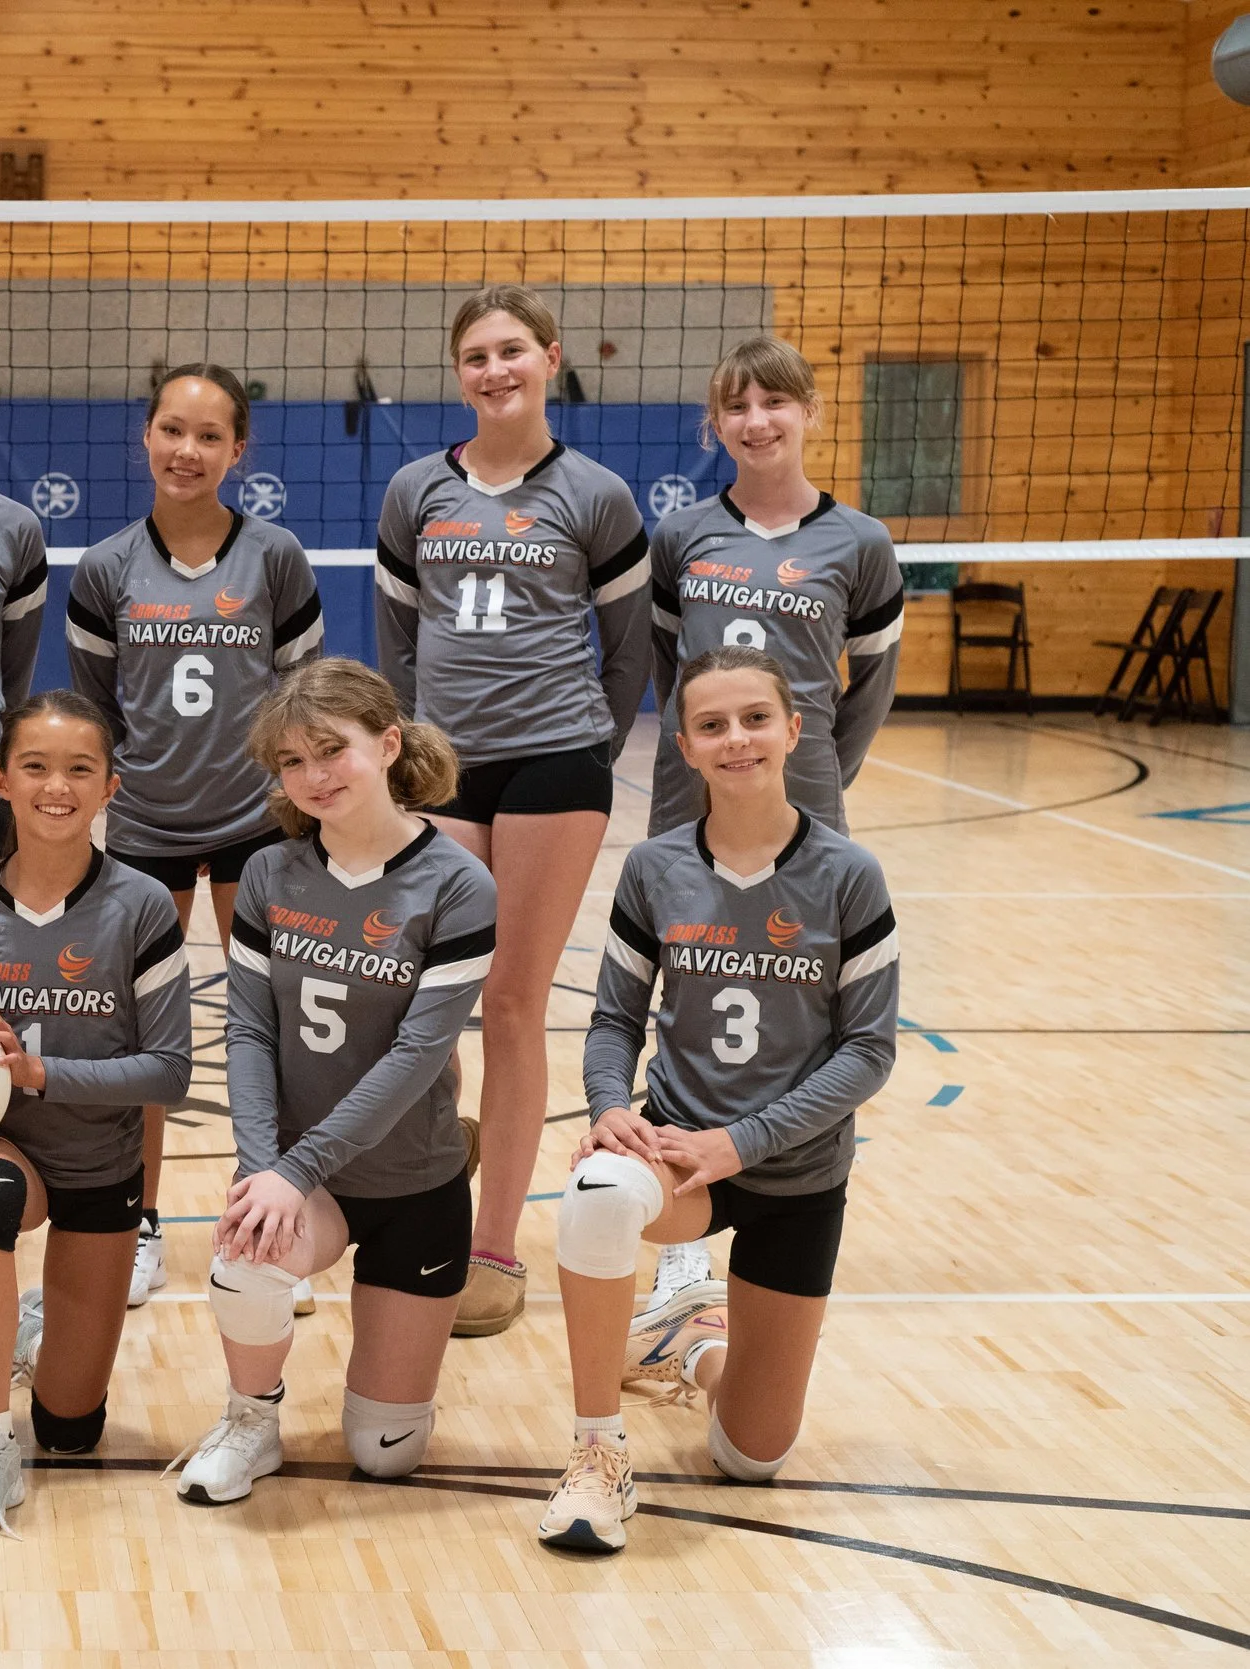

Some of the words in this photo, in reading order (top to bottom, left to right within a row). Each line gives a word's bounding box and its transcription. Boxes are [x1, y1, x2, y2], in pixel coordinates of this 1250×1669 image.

[421, 540, 557, 568] NAVIGATORS
[129, 602, 191, 620] COMPASS
[455, 572, 507, 631] 11
[683, 579, 825, 623] NAVIGATORS
[128, 624, 262, 648] NAVIGATORS
[172, 654, 214, 717] 6
[269, 904, 339, 938] COMPASS
[664, 923, 739, 945] COMPASS
[669, 946, 824, 985] NAVIGATORS
[300, 976, 348, 1054] 5
[711, 987, 761, 1065] 3
